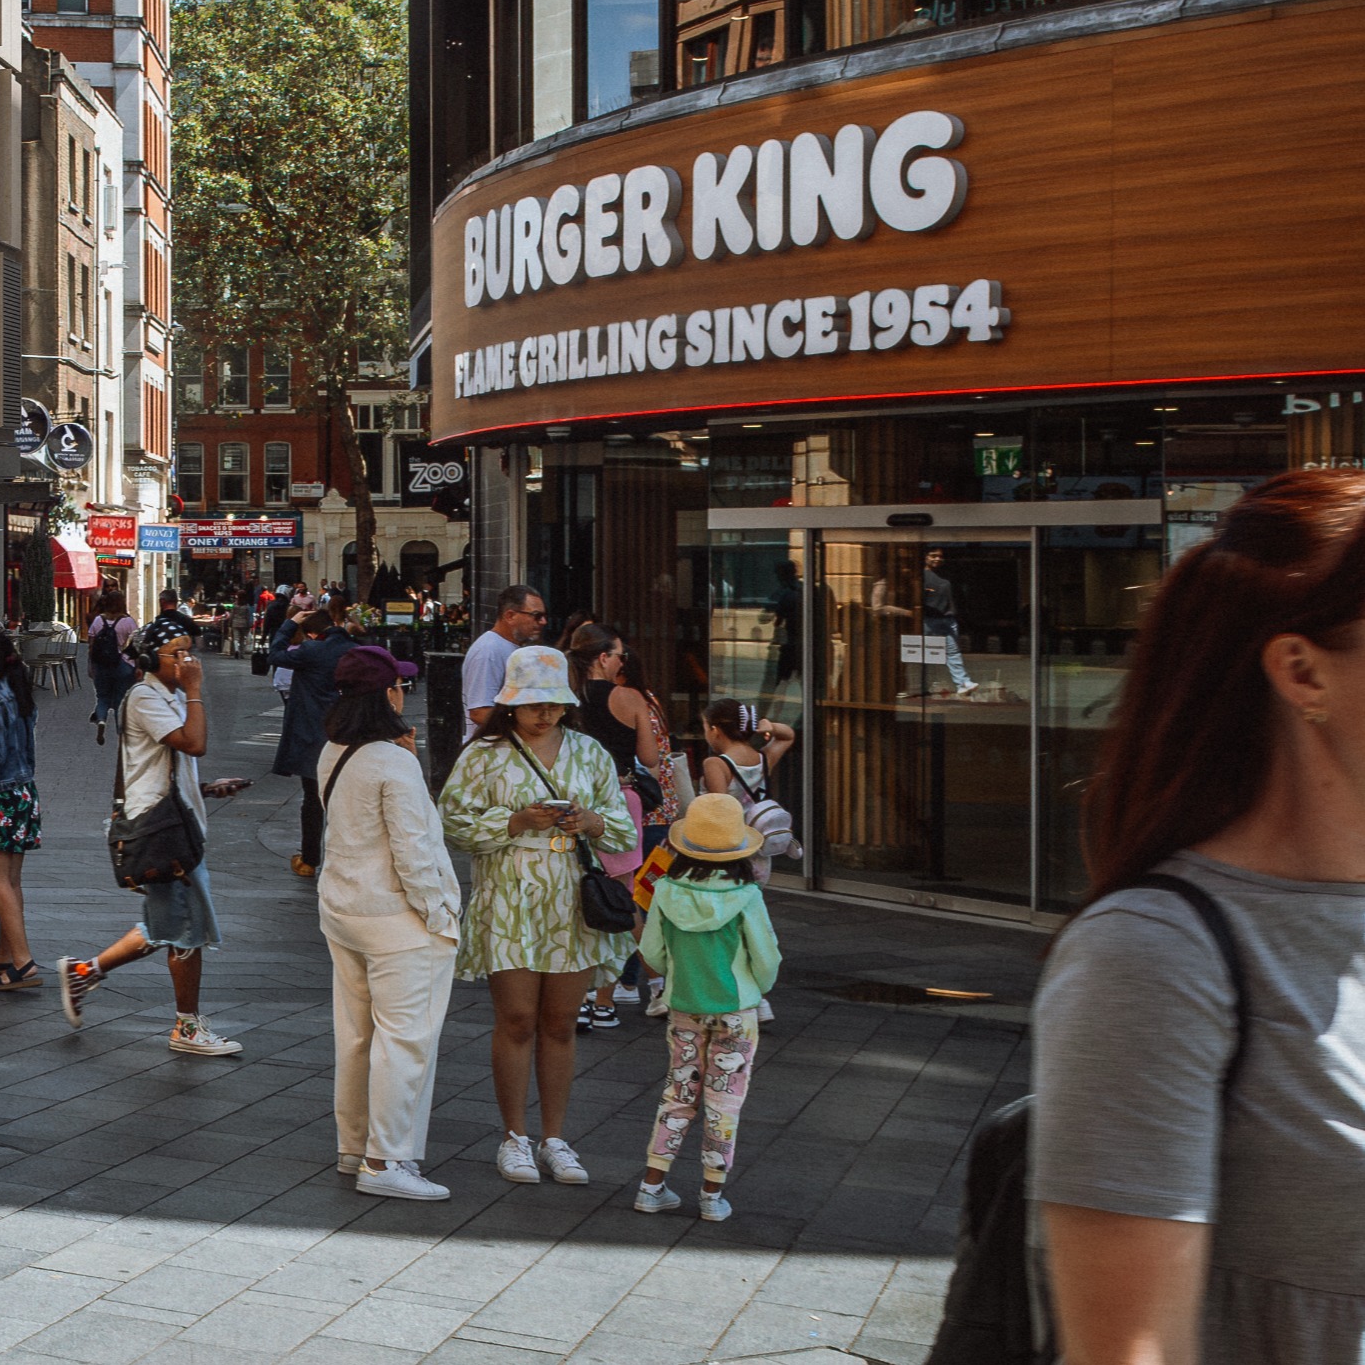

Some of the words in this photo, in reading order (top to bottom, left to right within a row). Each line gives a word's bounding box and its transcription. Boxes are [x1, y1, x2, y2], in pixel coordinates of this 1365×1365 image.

[464, 165, 684, 308] BURGER
[691, 110, 969, 261] KING
[454, 337, 519, 399] FLAME
[518, 314, 687, 386] GRILLING
[684, 296, 848, 368] SINCE
[848, 279, 1011, 351] 1954
[145, 529, 175, 537] MONEY
[87, 536, 134, 546] TOBACCO
[141, 540, 175, 548] CHANGE
[222, 538, 268, 546] EXCHANGE
